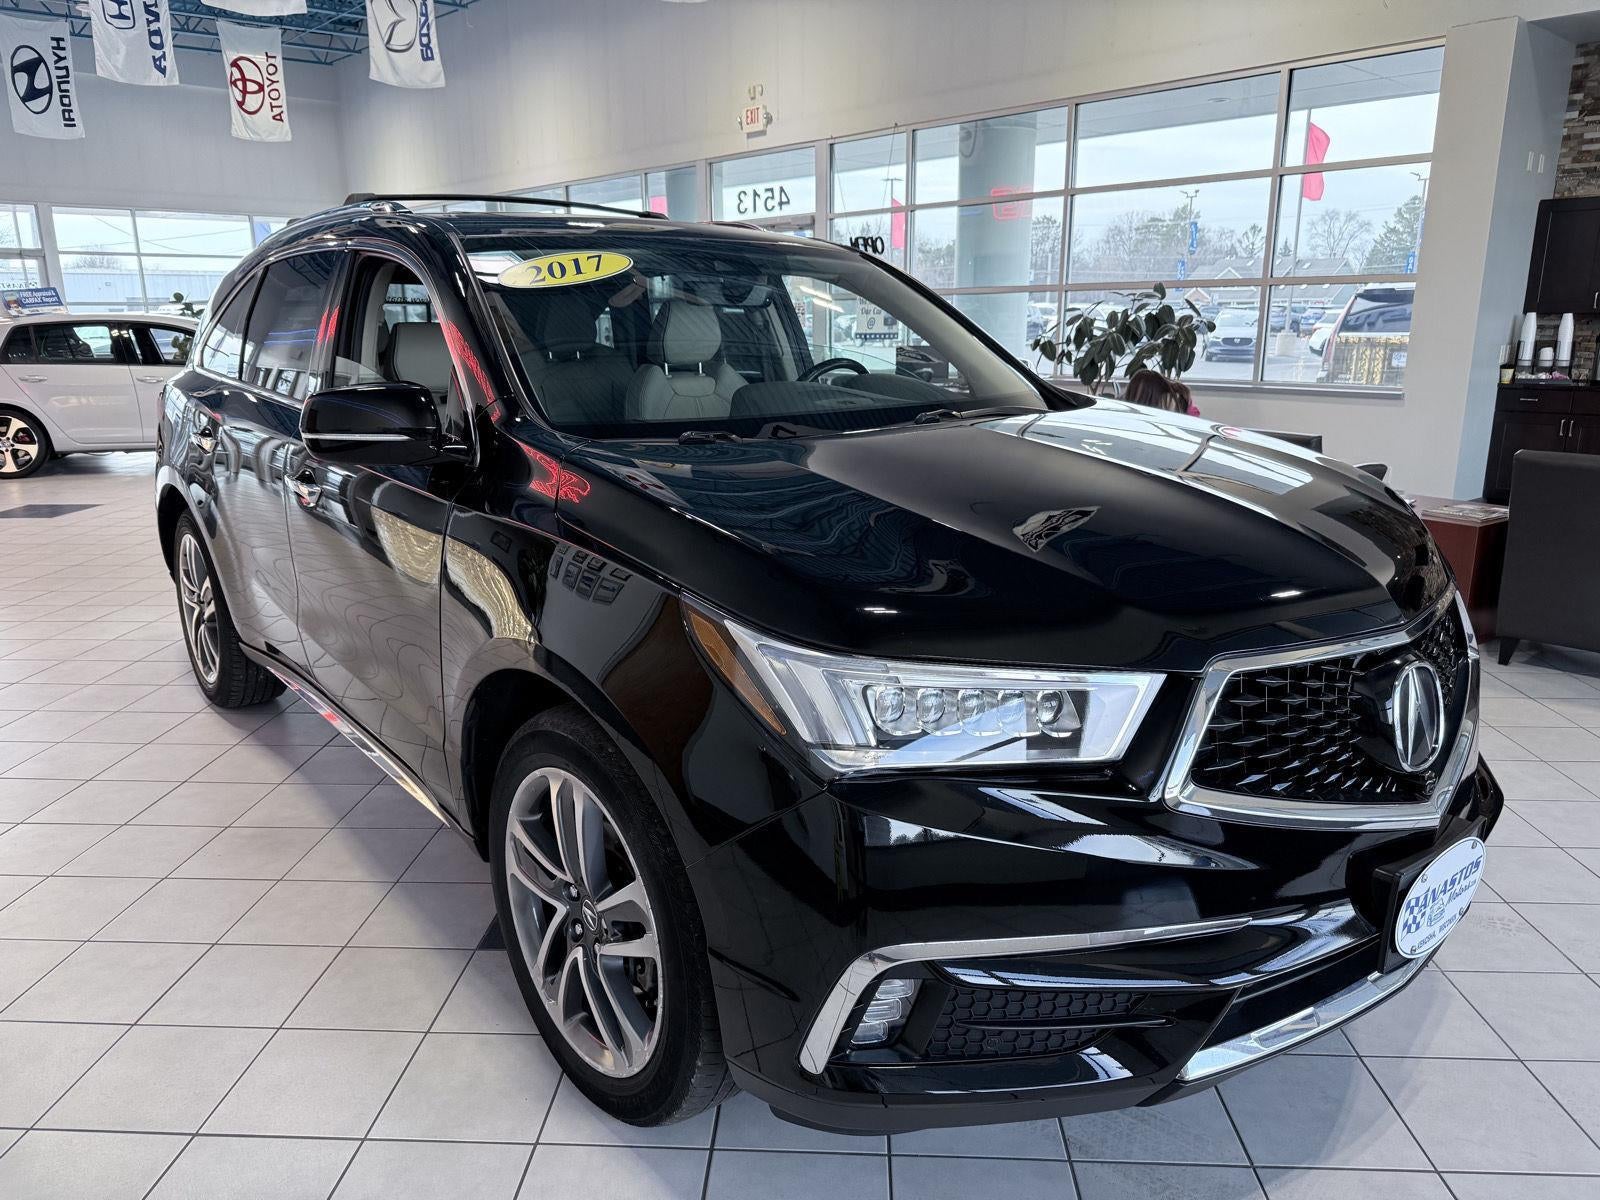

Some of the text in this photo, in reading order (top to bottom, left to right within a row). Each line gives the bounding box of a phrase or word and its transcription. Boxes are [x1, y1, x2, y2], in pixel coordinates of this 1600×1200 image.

[745, 106, 760, 126] EXIT
[525, 254, 602, 284] 2017
[1417, 855, 1483, 914] ANASTOS
